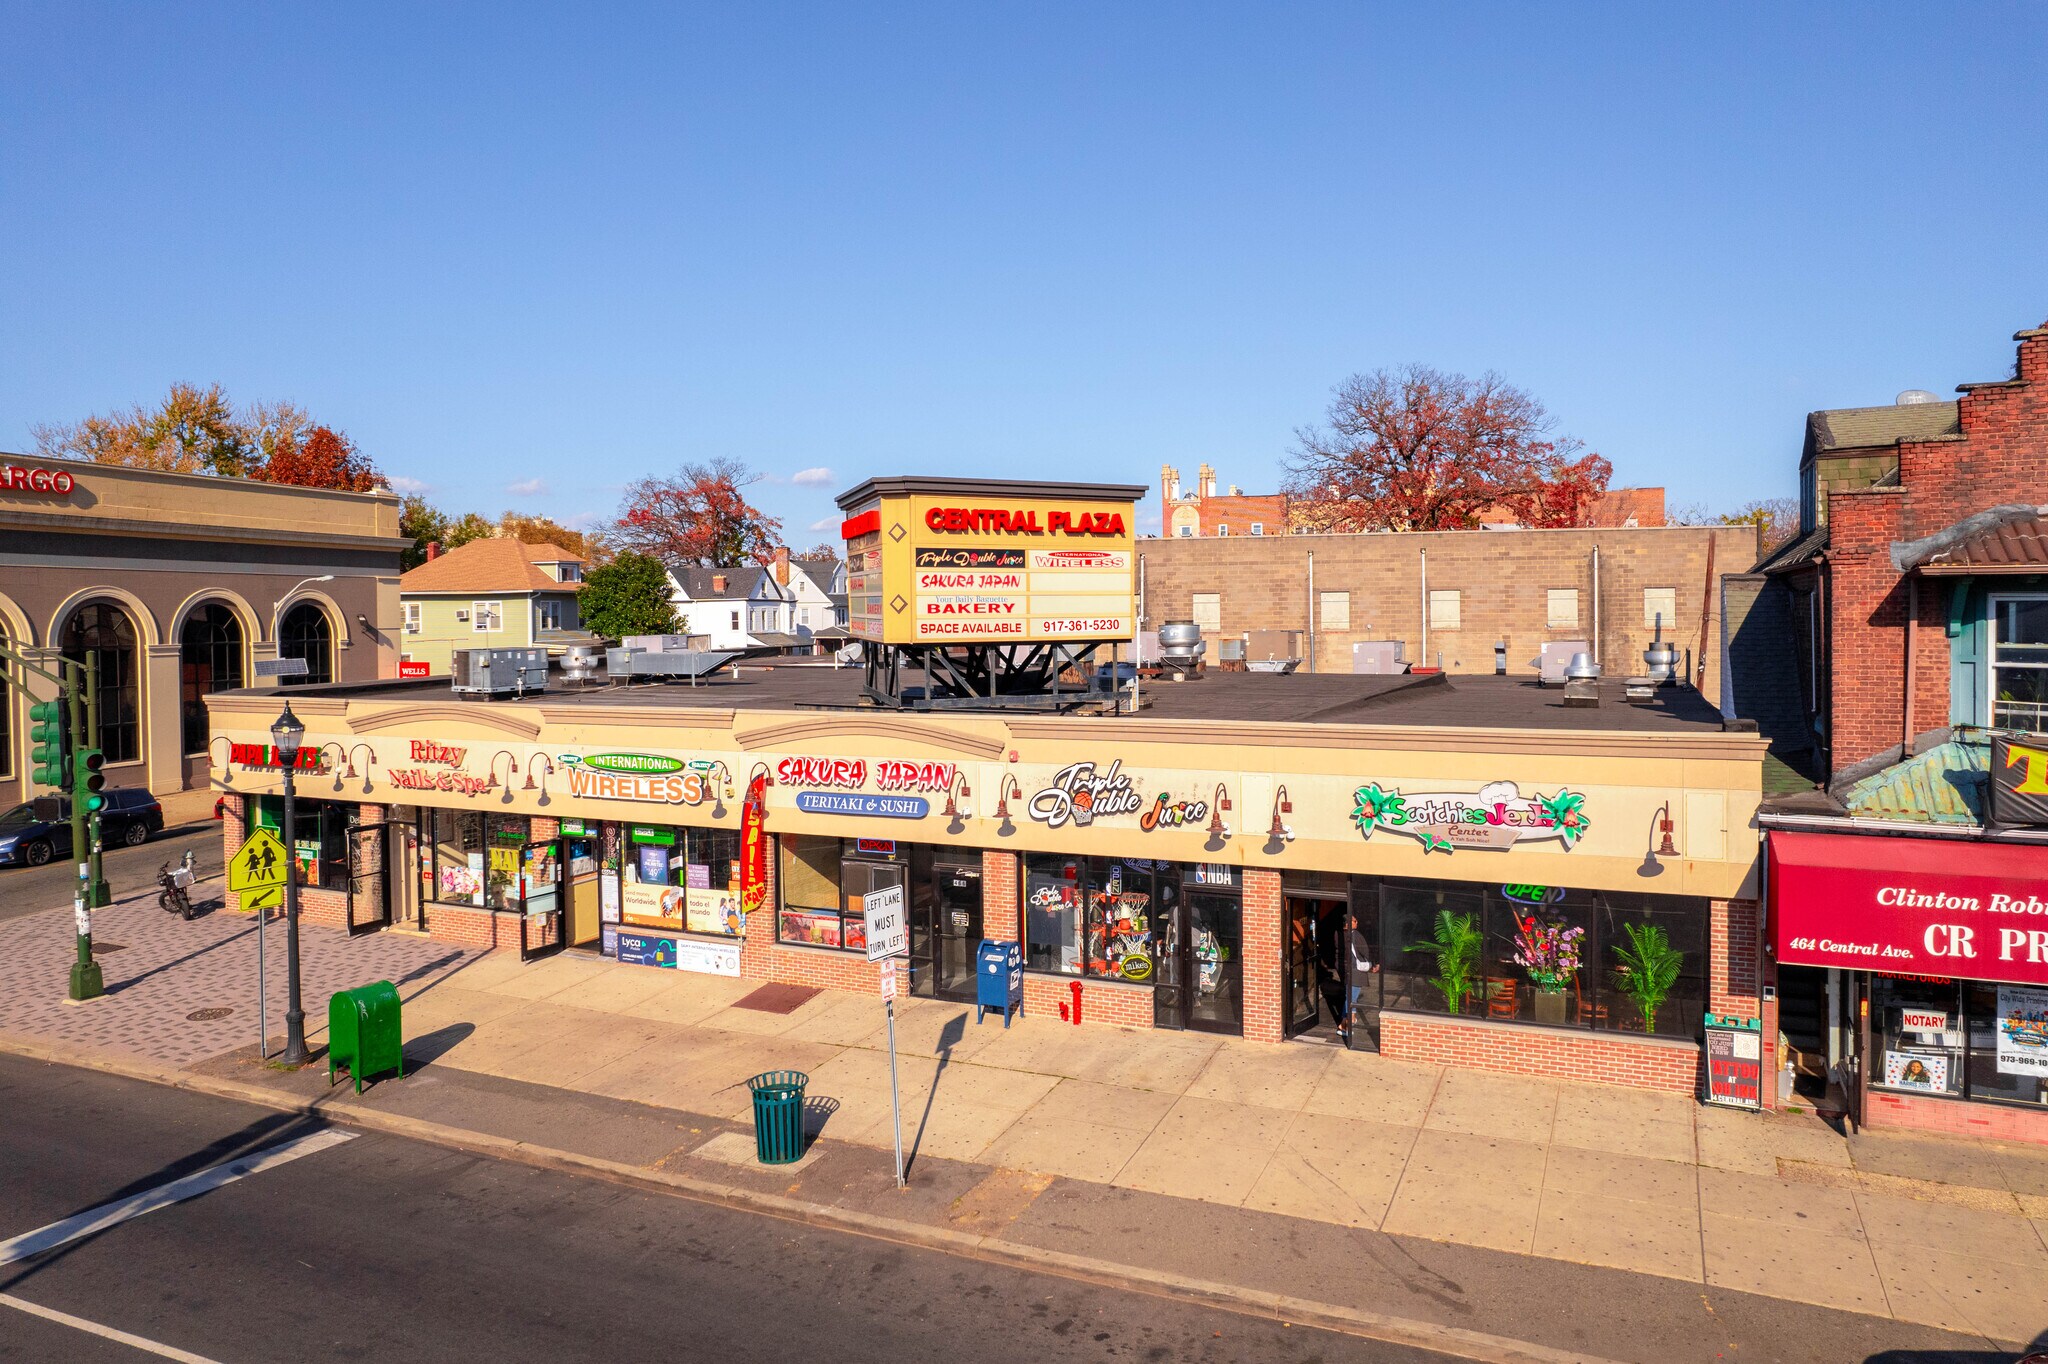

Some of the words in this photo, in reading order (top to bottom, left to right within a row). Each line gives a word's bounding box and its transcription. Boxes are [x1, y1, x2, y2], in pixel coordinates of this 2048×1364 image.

[925, 507, 1043, 532] CENTRAL
[1048, 511, 1126, 534] PLAZA
[917, 549, 952, 567] Triple
[954, 551, 996, 567] Double
[997, 551, 1023, 566] Juice
[1035, 556, 1124, 568] WIRELESS
[921, 574, 974, 588] SAKURA
[978, 574, 1021, 588] JAPAN
[927, 603, 1015, 614] BAKERY
[955, 596, 974, 604] Daily
[976, 596, 1008, 604] Baguette
[920, 623, 959, 633] SPACE
[961, 623, 1022, 633] AVAILABLE
[1043, 619, 1120, 632] 917-361-5230
[230, 744, 263, 766] PAPA
[409, 740, 465, 768] Ritzy
[595, 756, 675, 770] INTERNATIONAL
[388, 769, 437, 789] Nails
[436, 771, 448, 790] &
[452, 772, 486, 795] Spa
[778, 757, 867, 786] SAKURA
[876, 760, 956, 791] JAPAN
[1053, 759, 1130, 792] Triple
[567, 767, 702, 803] WIRELESS
[803, 795, 863, 810] TERIYAKI
[866, 799, 877, 811] &
[879, 799, 919, 814] SUSHI
[1029, 787, 1141, 826] Double
[1141, 797, 1207, 830] Juice
[1388, 797, 1487, 826] Scotchies
[1485, 802, 1555, 827] Jerk
[1448, 825, 1489, 836] Center
[859, 839, 893, 852] OPEN
[1112, 867, 1120, 893] OPEN
[1207, 863, 1232, 885] NBA
[625, 897, 657, 906] Worldwide
[866, 898, 881, 911] LEFT
[884, 893, 900, 907] LANE
[1506, 883, 1559, 904] OPEN
[1877, 887, 1980, 912] Clinton
[874, 914, 895, 932] MUST
[621, 936, 641, 948] Lyca
[869, 942, 886, 954] TURN
[888, 934, 904, 947] LEFT
[1789, 937, 1816, 950] 464
[1819, 939, 1879, 956] Central
[1881, 947, 1914, 959] Ave.
[1923, 923, 1977, 959] CR
[1998, 928, 2048, 963] PR
[2000, 993, 2011, 1003] City
[2012, 994, 2026, 1003] Wide
[2026, 996, 2048, 1007] Printing
[1904, 1014, 1945, 1028] NOTARY
[1727, 1075, 1737, 1084] AT
[1899, 1080, 1918, 1088] HARRIS
[1918, 1081, 1932, 1089] 2024
[1717, 1095, 1742, 1105] CENTRAL
